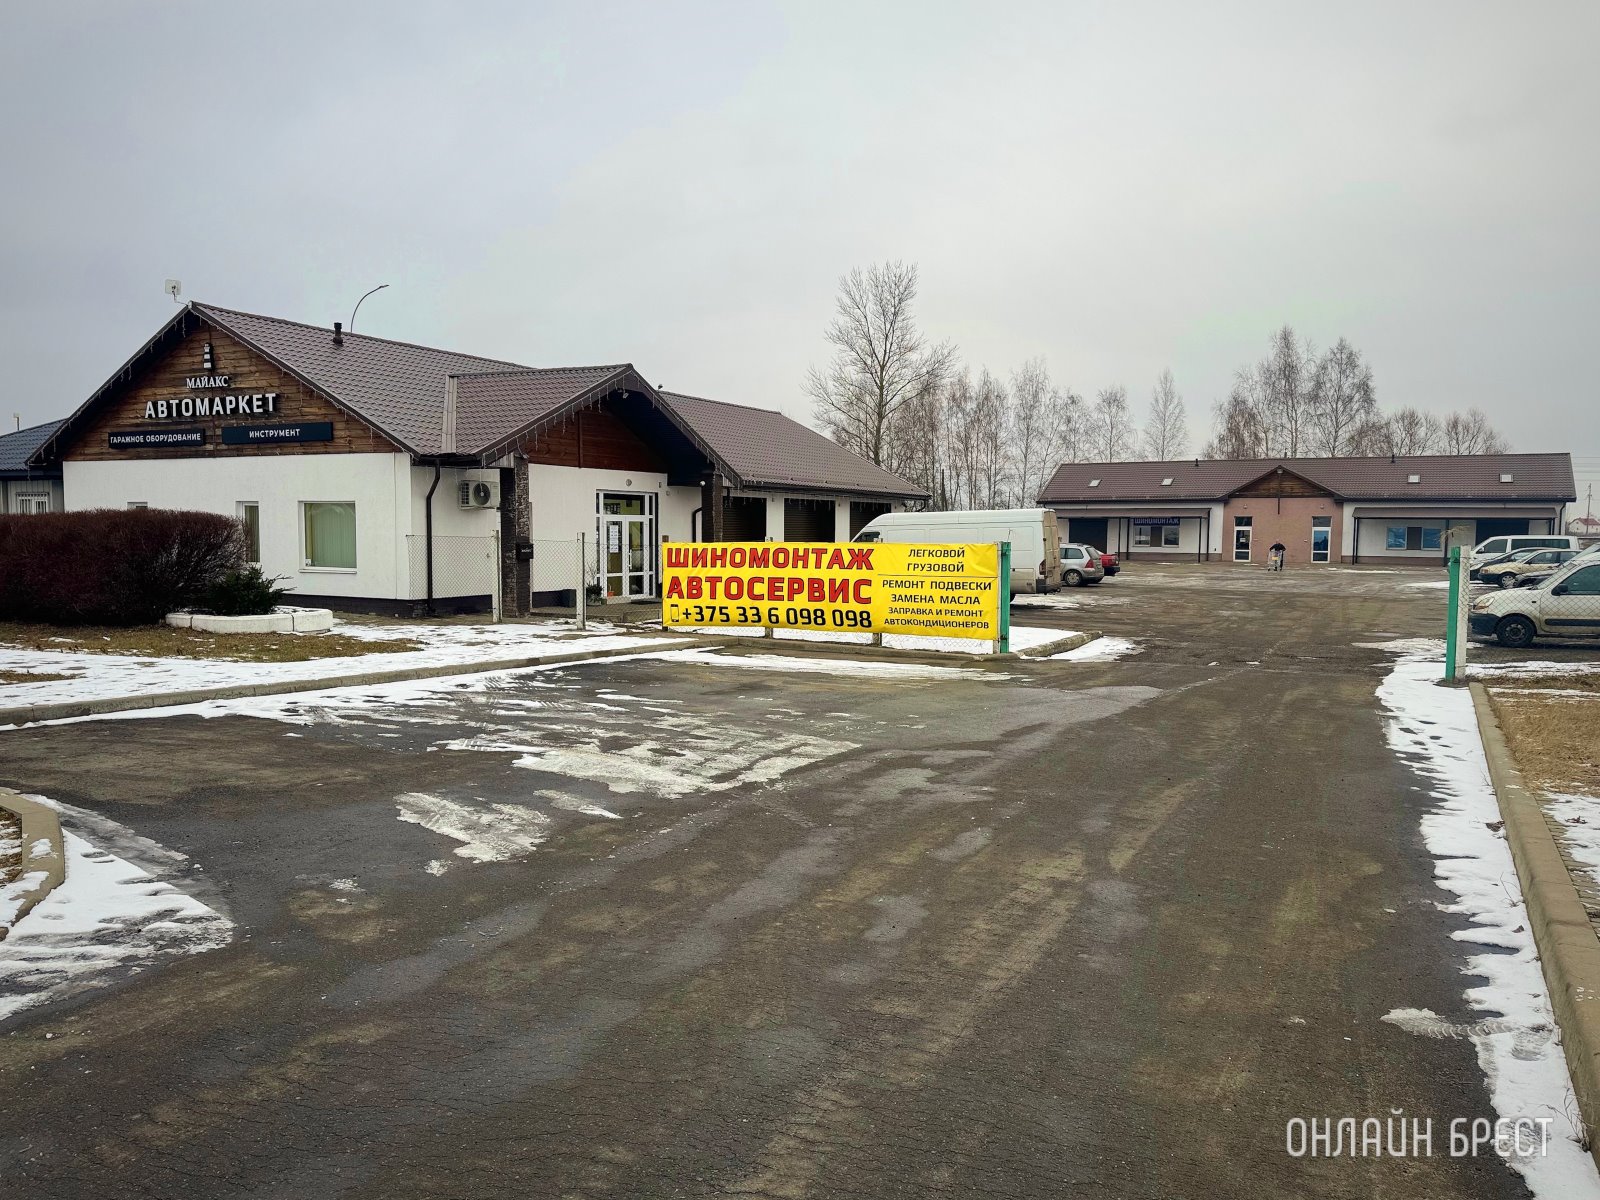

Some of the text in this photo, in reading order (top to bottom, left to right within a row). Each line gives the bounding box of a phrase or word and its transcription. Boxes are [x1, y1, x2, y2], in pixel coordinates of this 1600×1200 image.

[186, 375, 229, 389] МАЙАКС
[145, 393, 276, 418] АВТОМАРКЕТ
[110, 433, 201, 444] ГАРАЖНОЕ ОБОРУДОВАНИЕ
[249, 428, 300, 438] ИНСТРУМЕНТ
[908, 547, 965, 558] ЛЕГКОВОЙ
[666, 547, 874, 570] ШИНОМОНТАЖ
[907, 562, 964, 573] ГРУЗОВОЙ
[666, 576, 872, 604] АВТОСЕРВИС
[882, 580, 992, 591] РЕМОНТ ПОДВЕСКИ
[891, 594, 980, 605] ЗАМЕНА МАСЛА
[682, 606, 872, 628] +375 33 6 098 098
[888, 607, 933, 616] ЗАПРАВКА
[884, 618, 989, 629] АВТОКОНДИЦИОНЕРОВ
